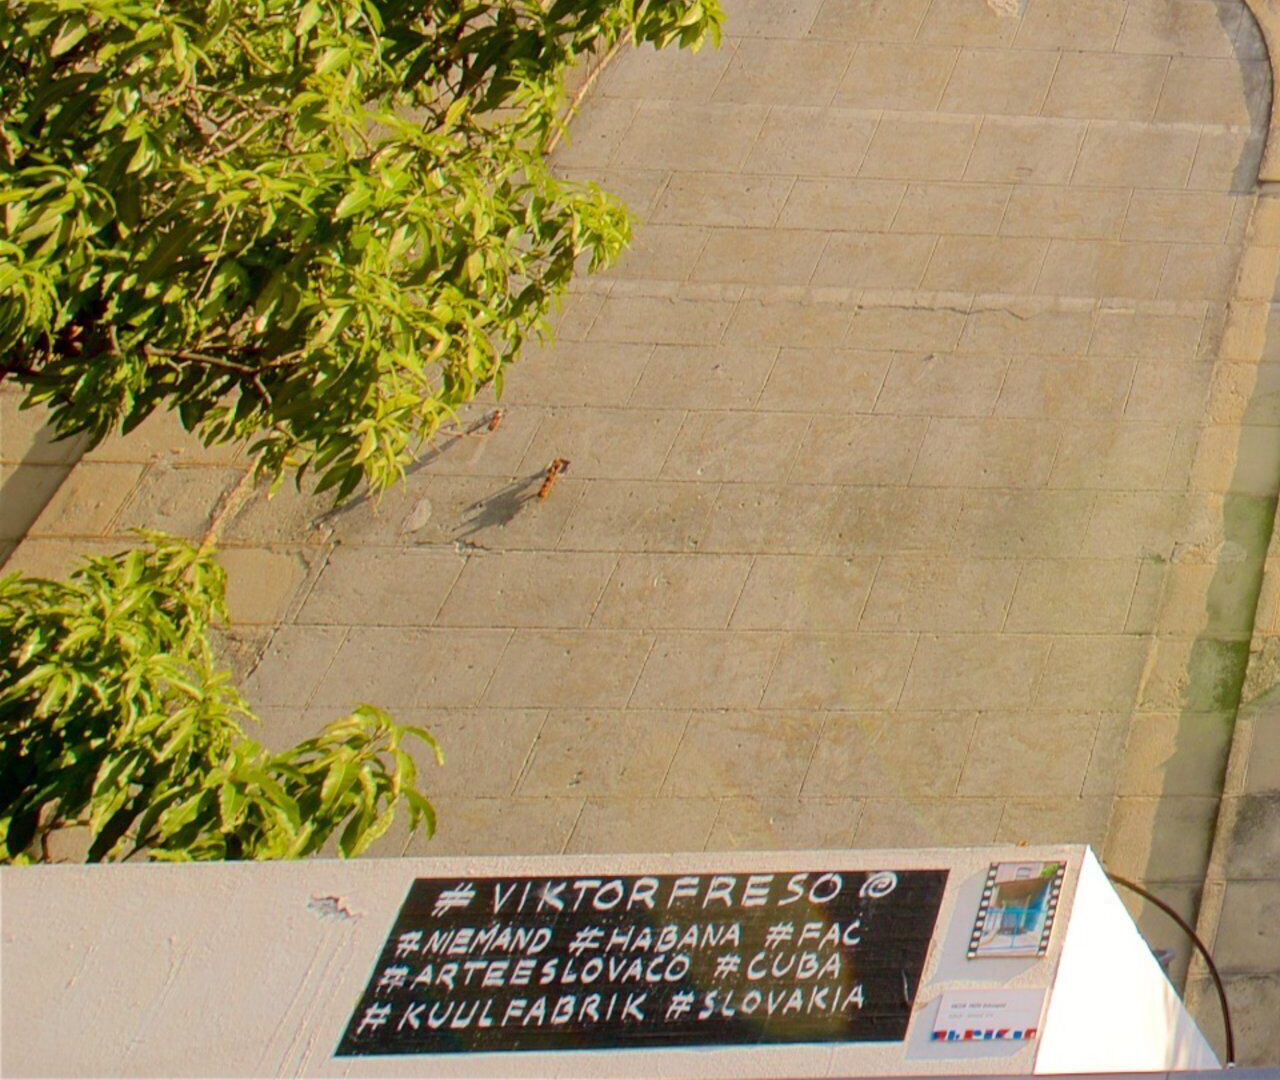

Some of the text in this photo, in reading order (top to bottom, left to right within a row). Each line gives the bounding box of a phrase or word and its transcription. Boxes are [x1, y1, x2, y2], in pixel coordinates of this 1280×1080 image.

[396, 920, 861, 957] #NIEMAND #HABANA #FAC
[378, 951, 842, 992] #ARTEESLOVACO #CUBA
[666, 984, 864, 1021] #SLOVAKIA
